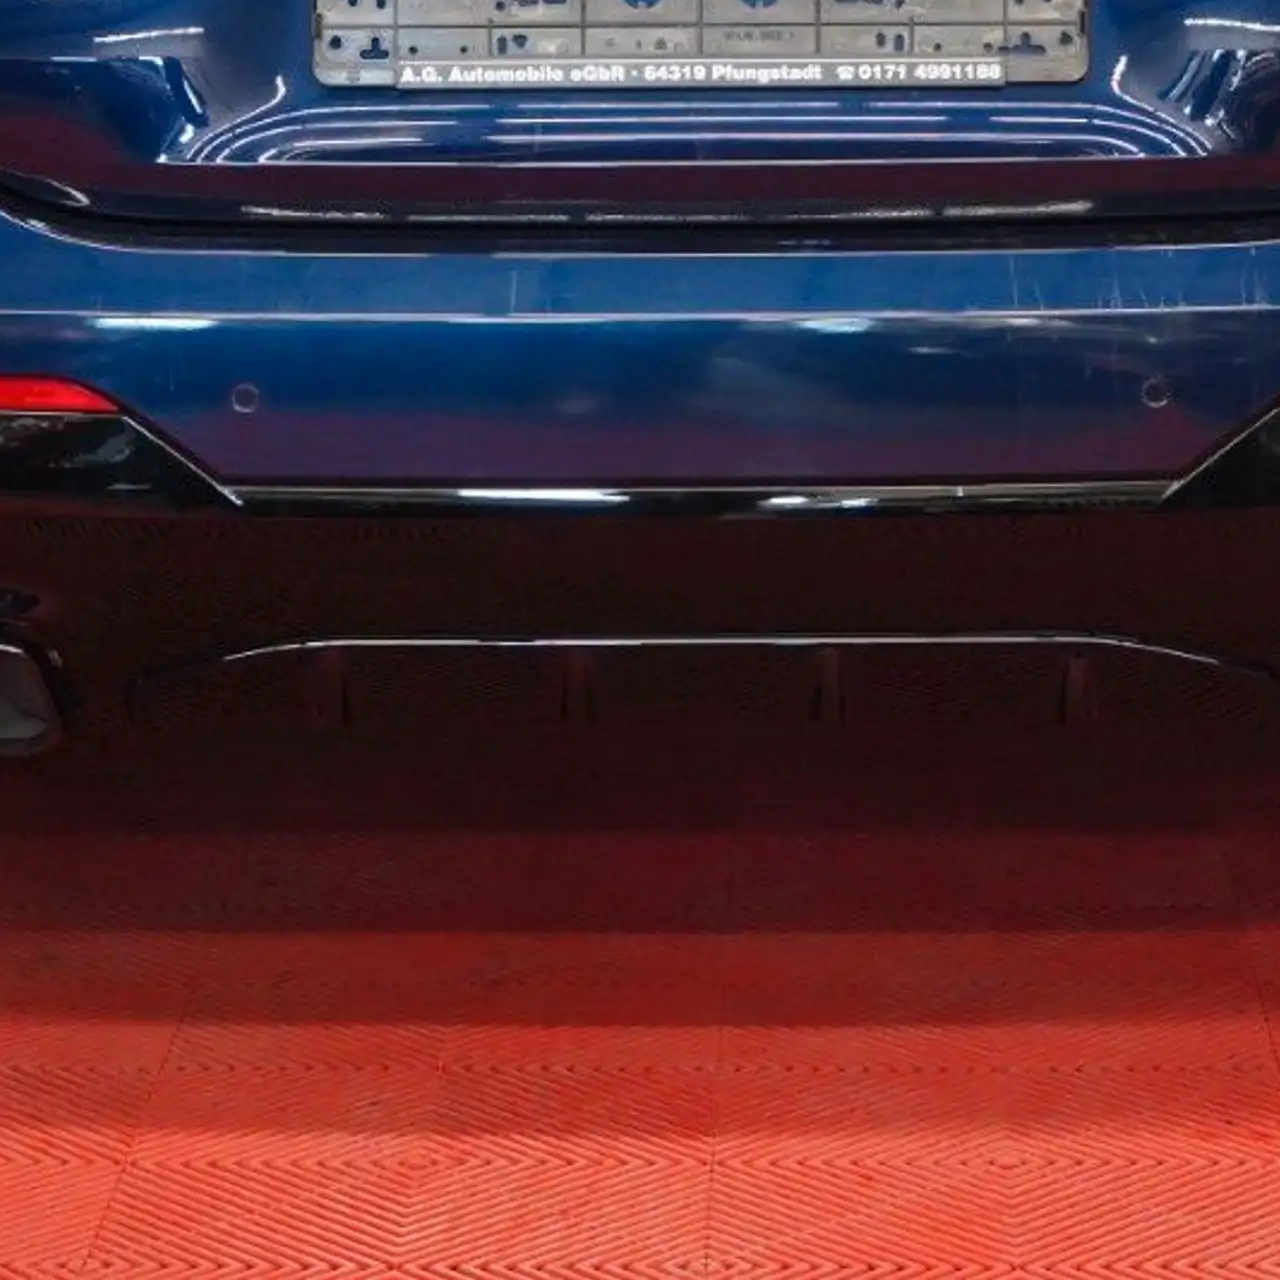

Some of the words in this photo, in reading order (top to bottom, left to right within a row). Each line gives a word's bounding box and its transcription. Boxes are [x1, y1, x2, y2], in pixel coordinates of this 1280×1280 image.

[400, 66, 443, 83] A.G.
[448, 65, 564, 83] Automobile
[644, 65, 706, 81] 64319
[712, 64, 822, 83] Pfungstadt
[858, 64, 907, 80] 0171
